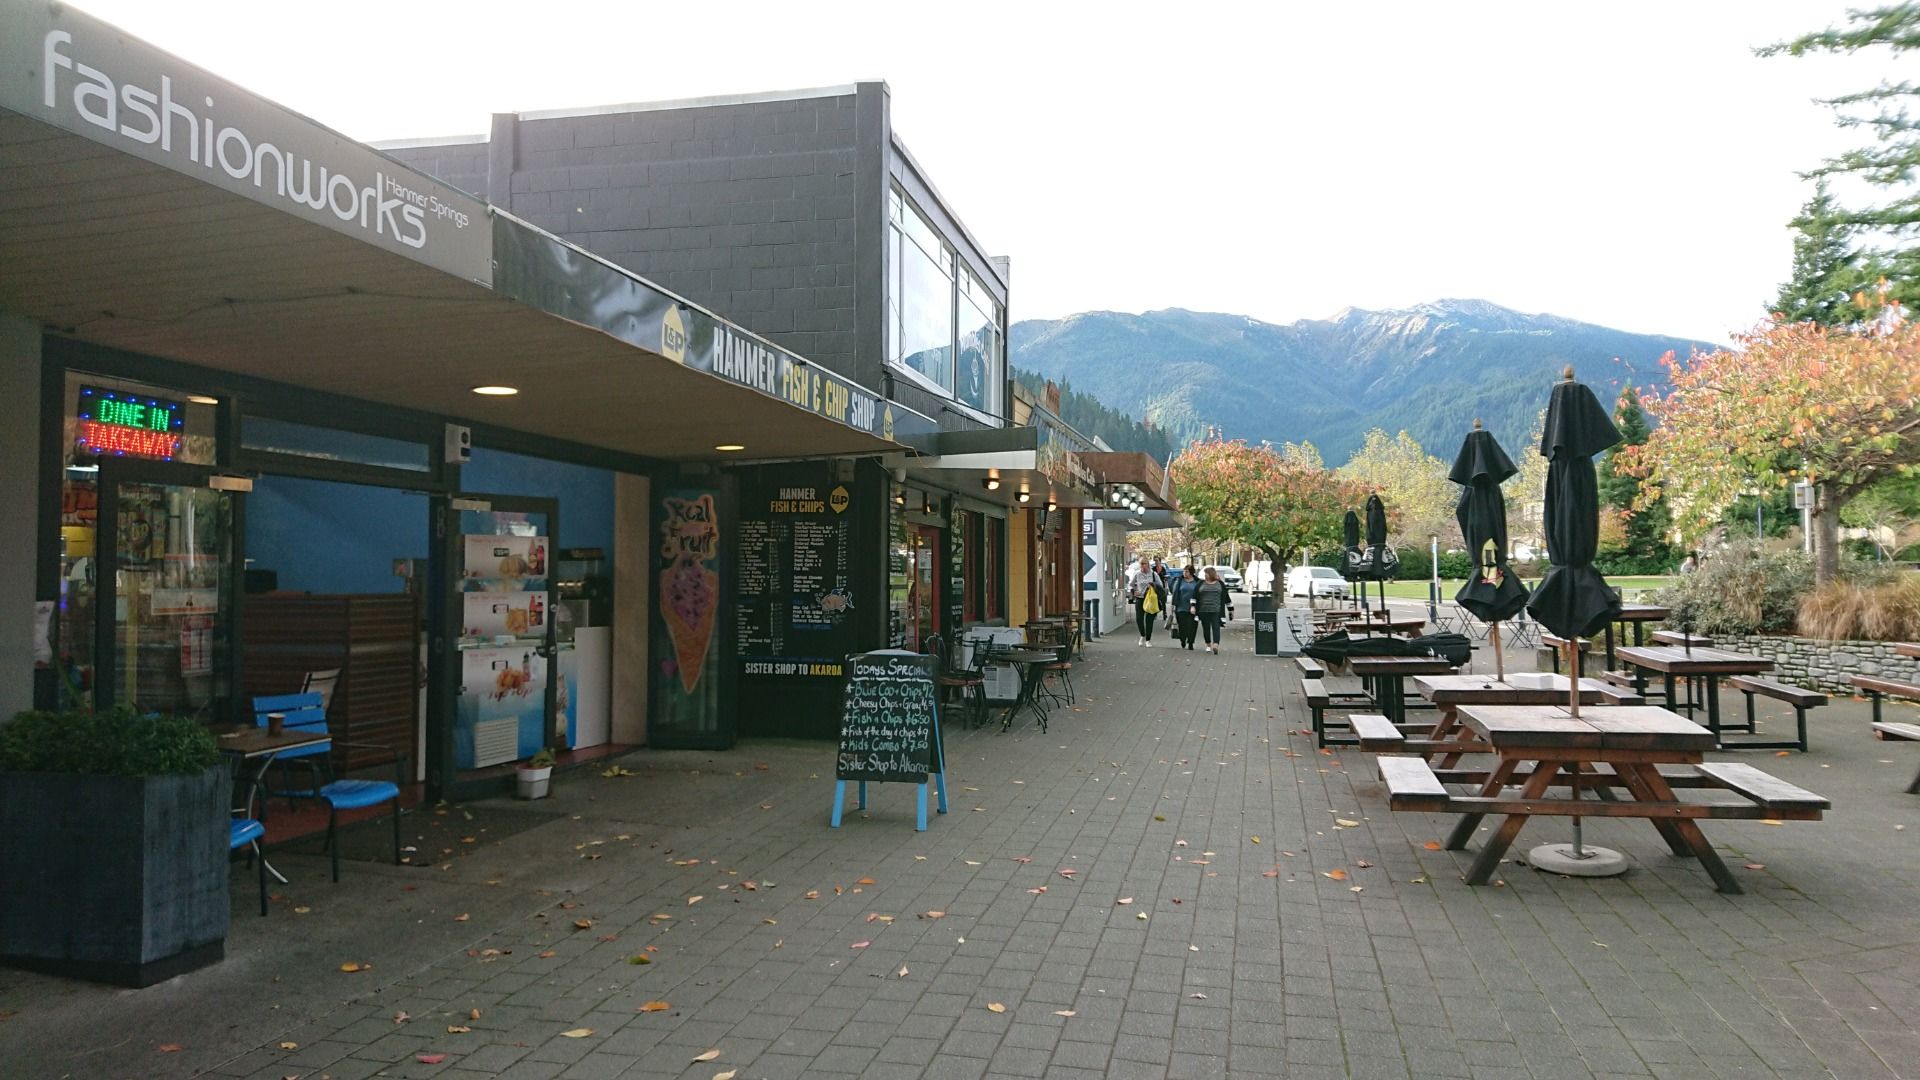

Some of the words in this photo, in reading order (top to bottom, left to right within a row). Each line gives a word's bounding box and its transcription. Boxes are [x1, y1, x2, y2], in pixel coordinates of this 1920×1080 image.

[44, 30, 427, 249] fashionworks
[386, 175, 428, 208] Hanmer
[430, 196, 469, 229] Springs
[713, 326, 776, 394] HANMER
[783, 359, 809, 408] FISH
[824, 379, 849, 422] CHIP
[851, 391, 875, 432] SHOP
[101, 399, 145, 429] DINE
[152, 407, 171, 433] IN
[89, 422, 178, 457] TAKEAWAY
[780, 488, 816, 500] HANMER
[771, 501, 789, 513] FISH
[799, 501, 824, 513] CHIPS
[745, 662, 773, 674] SISTER
[775, 663, 796, 675] SHOP
[798, 664, 808, 675] TO
[810, 664, 842, 676] AKAROA
[852, 709, 872, 724] Fish
[881, 710, 903, 728] Chips
[848, 724, 863, 738] Fish
[864, 726, 870, 739] of
[881, 725, 893, 740] day
[838, 752, 867, 771] Sister
